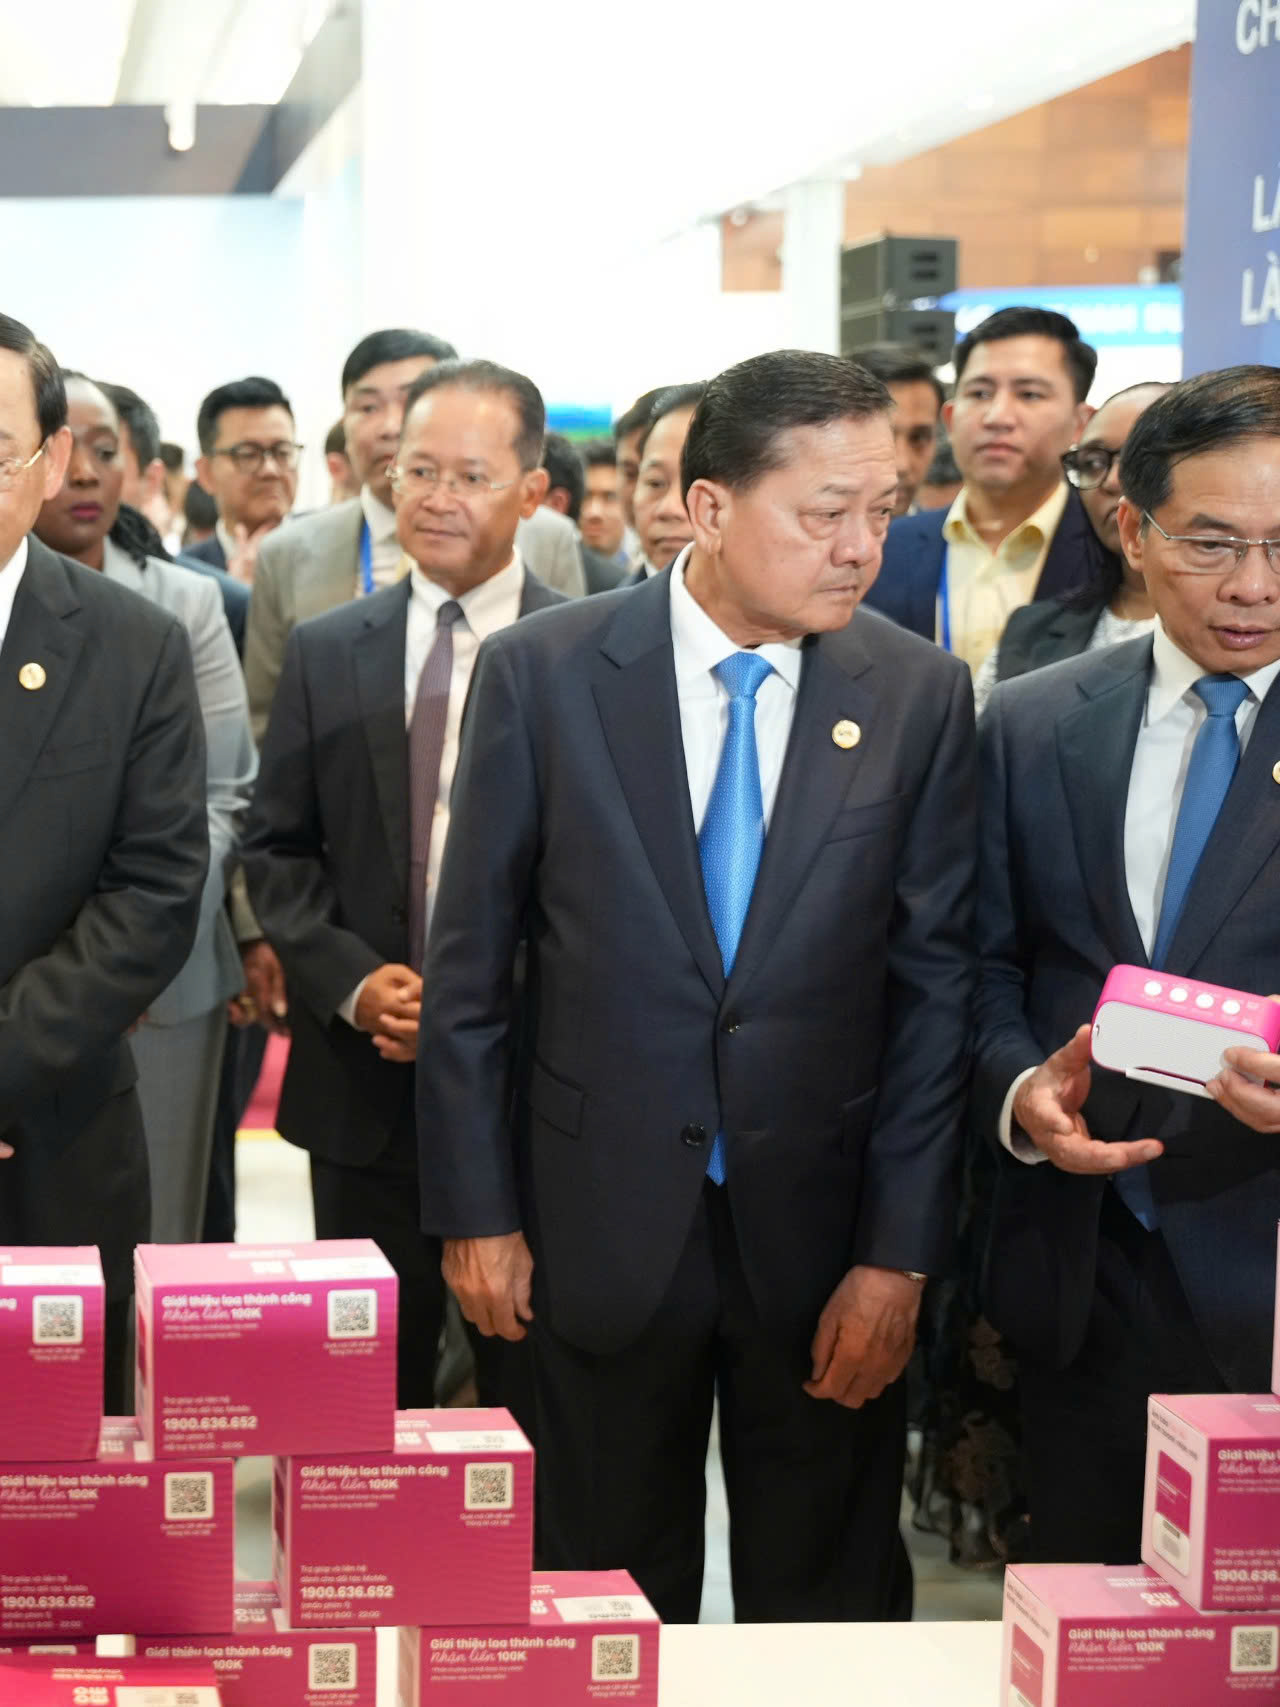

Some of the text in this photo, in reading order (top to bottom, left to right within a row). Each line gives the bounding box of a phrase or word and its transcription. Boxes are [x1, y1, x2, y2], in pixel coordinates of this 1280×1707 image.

[163, 1416, 257, 1429] 1900.636.652
[360, 1466, 379, 1476] loa
[369, 1479, 398, 1489] 100K
[1213, 1569, 1280, 1581] 1900.636.
[301, 1585, 394, 1598] 1900.636.652
[1, 1595, 95, 1609] 1900.636.652
[431, 1636, 576, 1649] Giới thiệu loa thành công
[204, 1647, 224, 1656] loa
[497, 1651, 527, 1661] 100K
[213, 1660, 243, 1670] 100K
